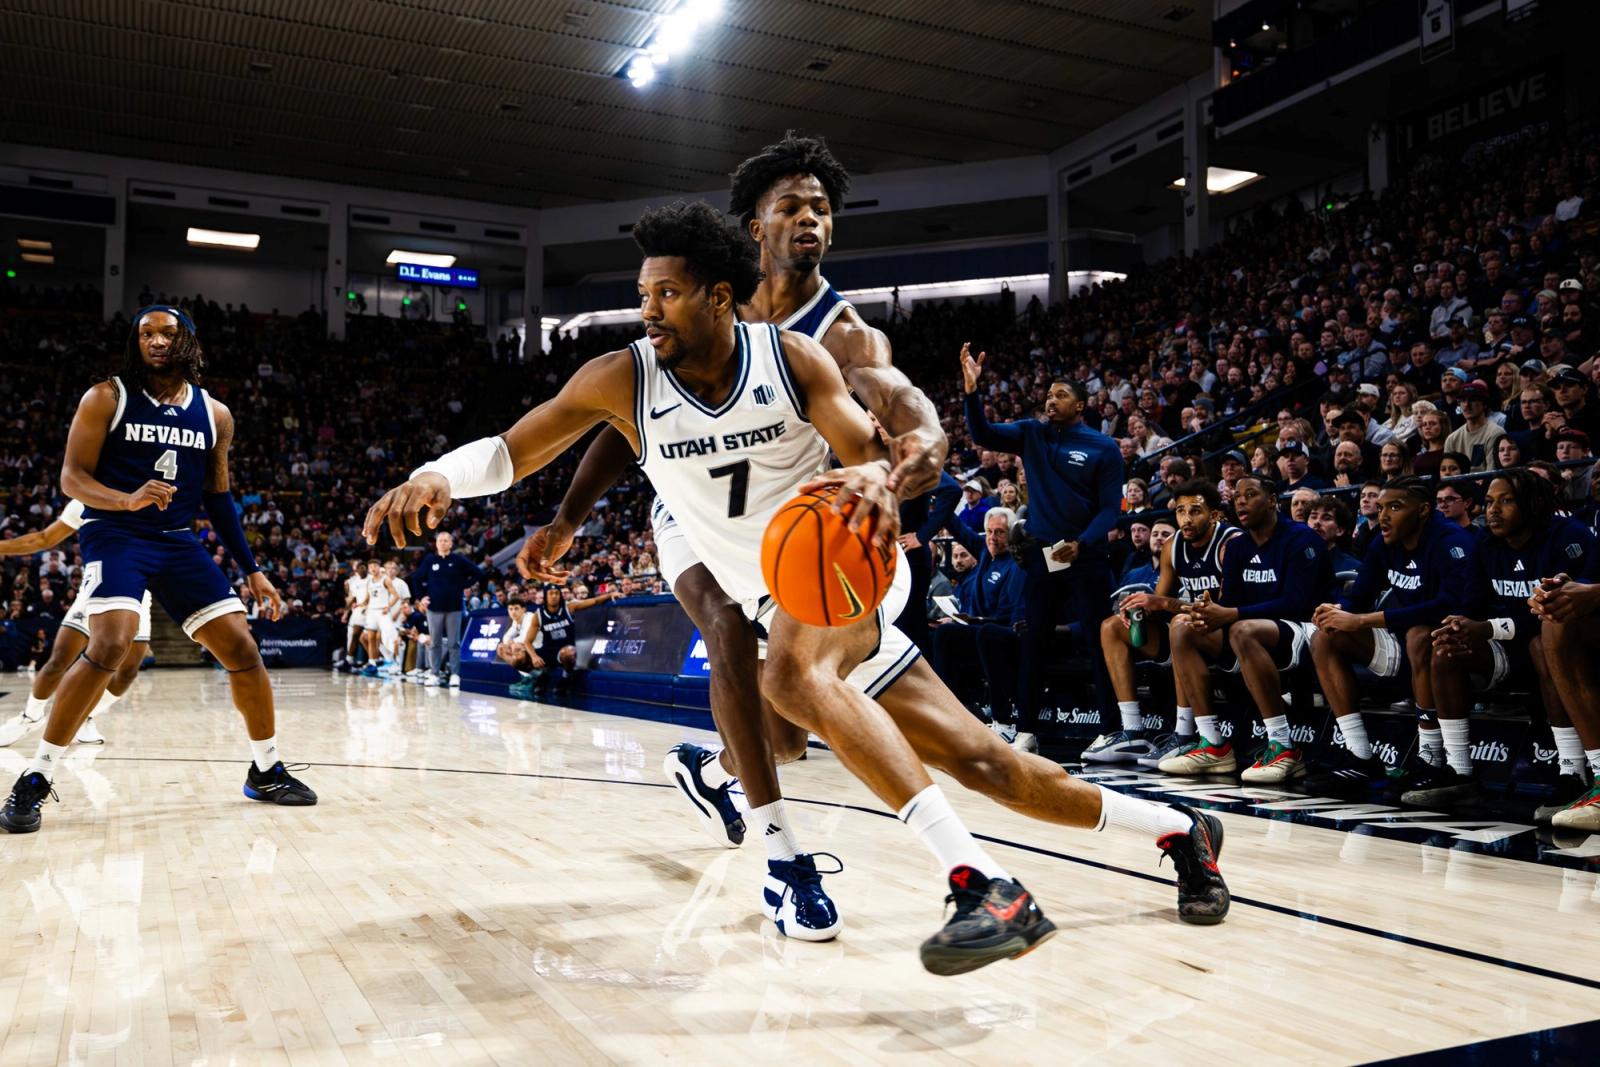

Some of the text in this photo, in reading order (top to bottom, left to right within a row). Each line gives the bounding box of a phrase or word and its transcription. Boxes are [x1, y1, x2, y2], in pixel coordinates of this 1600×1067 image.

[1430, 15, 1441, 33] 5
[1426, 72, 1549, 143] BELIEVE
[110, 264, 119, 277] S
[421, 268, 452, 281] Evans
[124, 422, 207, 450] NEVADA
[659, 420, 787, 459] UTAH STATE
[153, 448, 179, 480] 4
[708, 458, 751, 518] 7
[1068, 706, 1101, 724] Smith
